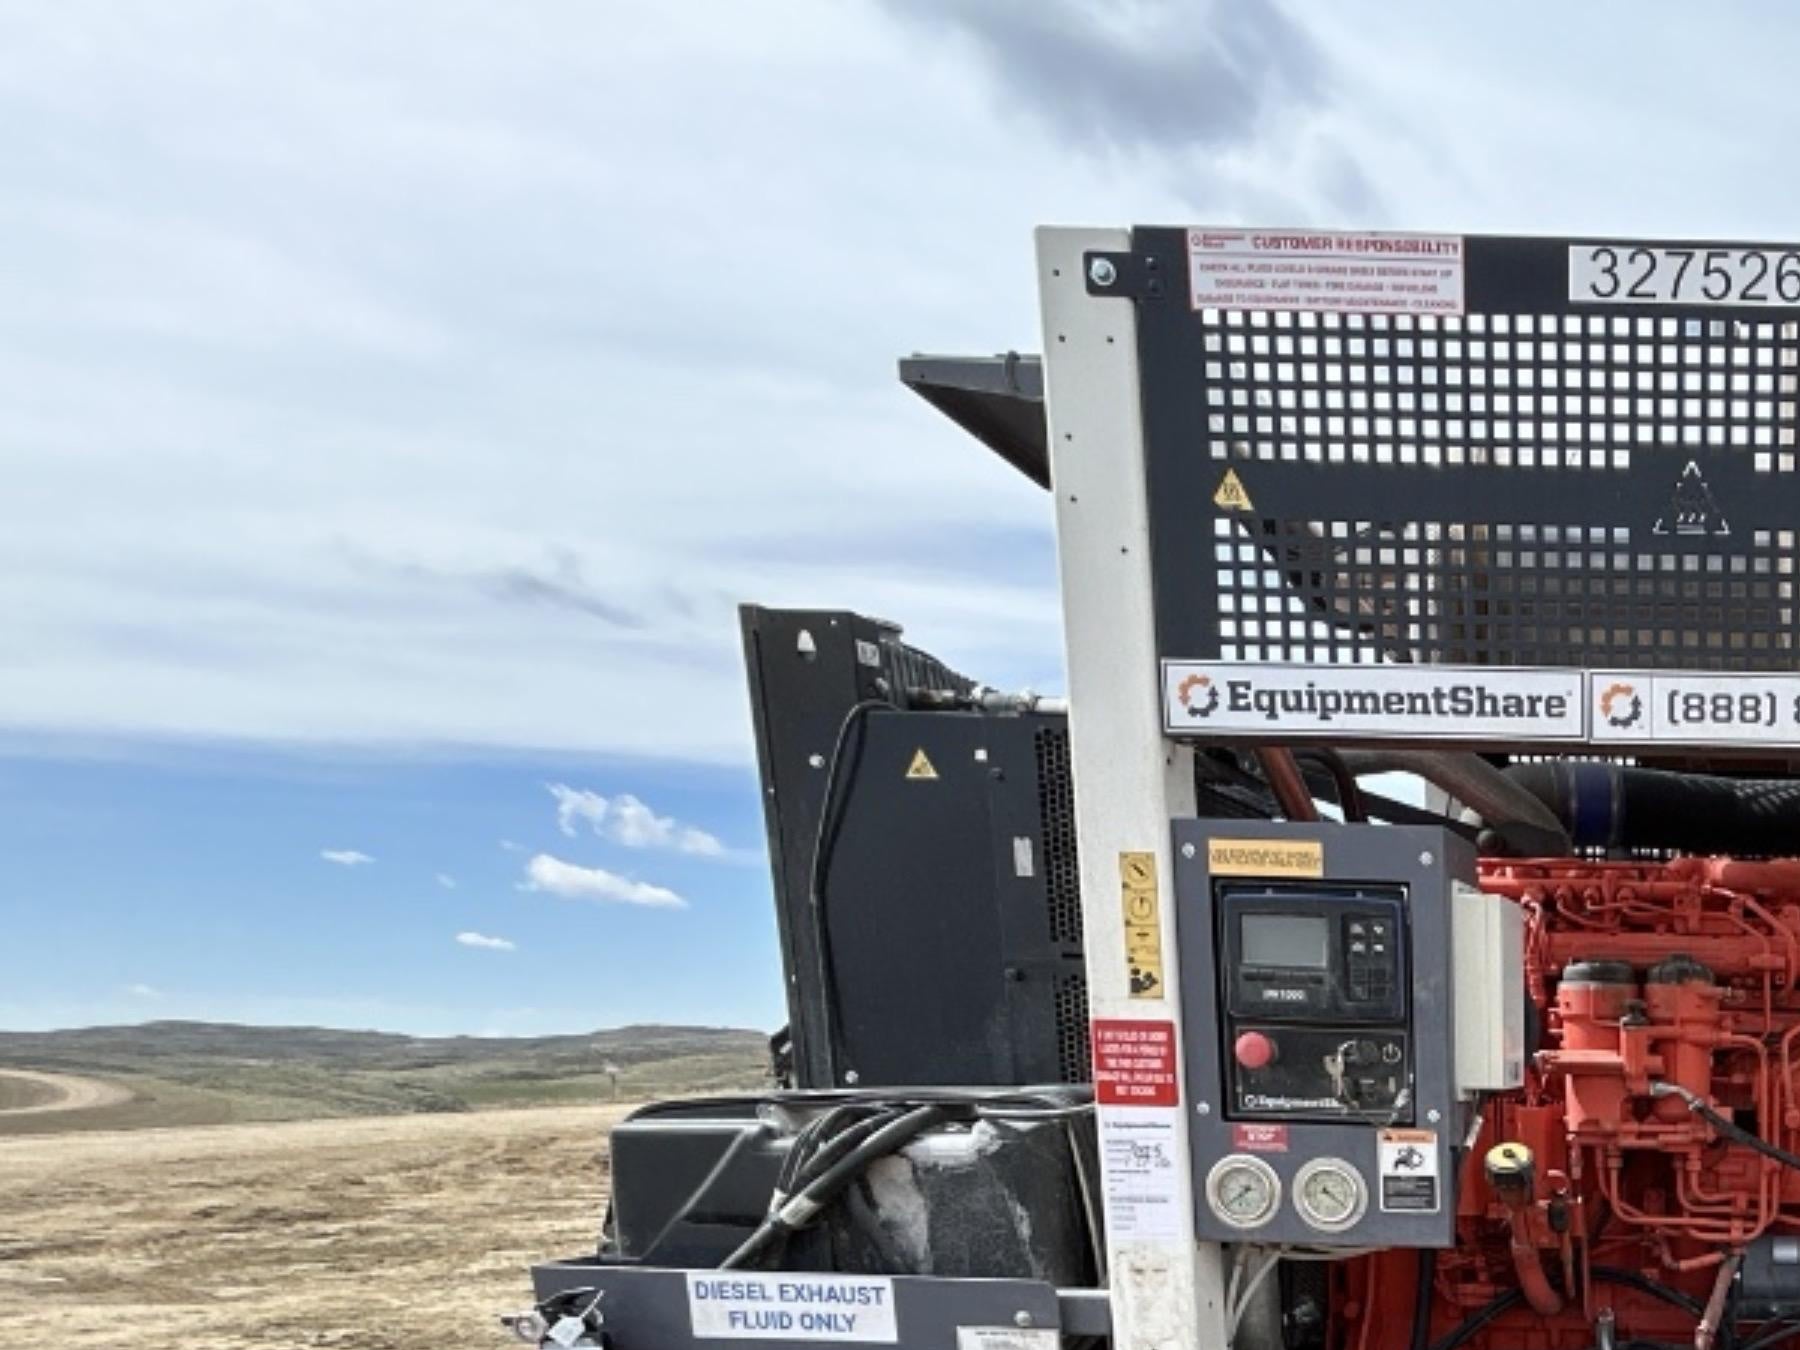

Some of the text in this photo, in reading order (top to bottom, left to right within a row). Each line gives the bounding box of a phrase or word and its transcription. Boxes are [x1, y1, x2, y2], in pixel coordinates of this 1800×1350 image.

[1252, 235, 1334, 250] CUSTOMER
[1337, 238, 1460, 256] RESPONSIBILITY
[1226, 681, 1569, 721] EquipmentShare
[1667, 690, 1778, 727] (888)
[695, 1280, 886, 1306] DIESEL EXHAUST
[728, 1310, 857, 1333] FLUID ONLY
